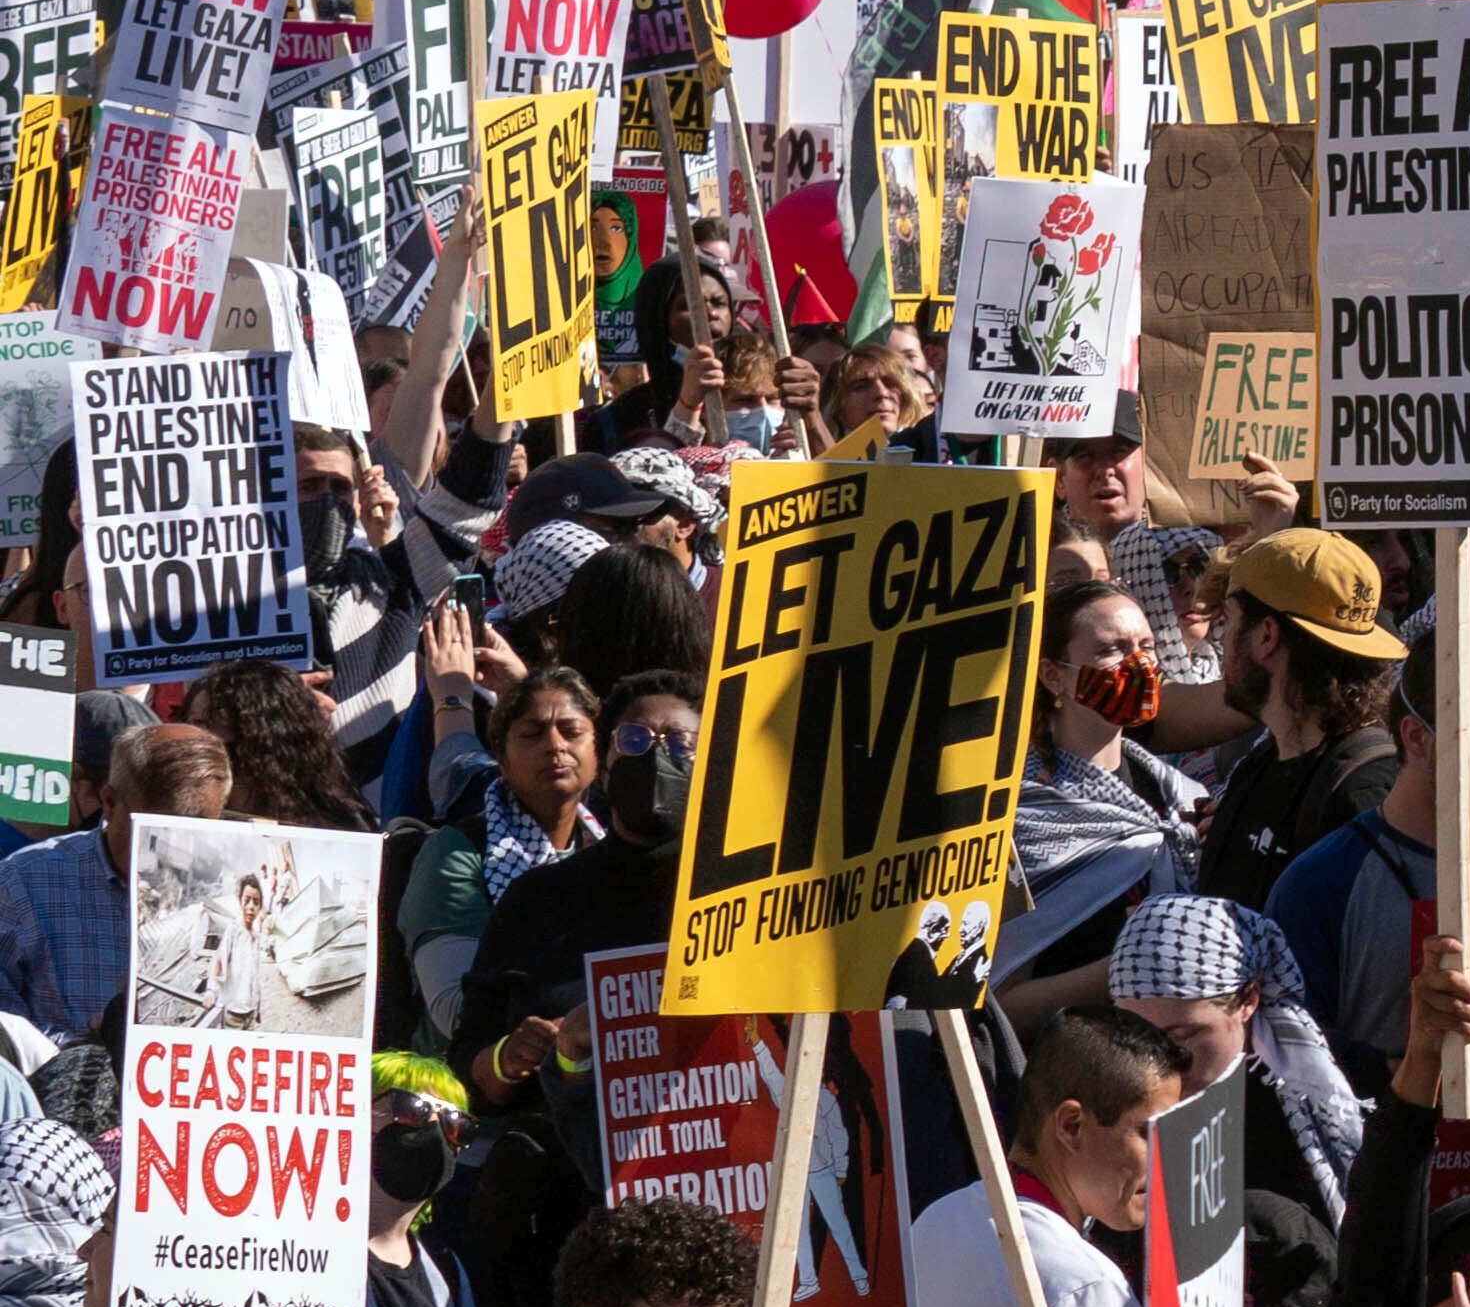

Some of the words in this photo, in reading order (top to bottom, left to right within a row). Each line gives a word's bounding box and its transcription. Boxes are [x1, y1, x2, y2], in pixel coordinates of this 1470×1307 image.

[193, 3, 272, 53] GAZA
[135, 31, 249, 102] LIVE!
[945, 23, 1019, 95] END
[1028, 31, 1091, 103] THE
[1329, 40, 1439, 140] FREE
[102, 123, 186, 166] FREE
[189, 140, 241, 180] ALL
[1013, 104, 1090, 176] WAR
[98, 157, 240, 206] PALESTINIAN
[1164, 151, 1211, 190] US
[91, 179, 235, 231] PRISONERS
[1154, 214, 1300, 255] ALREADY
[71, 266, 216, 340] NOW
[85, 359, 190, 409] STAND
[202, 358, 278, 393] WITH
[983, 380, 1020, 400] LIFT
[1020, 384, 1048, 401] THE
[1049, 386, 1086, 402] SIEGE
[1207, 343, 1313, 412] FREE
[89, 402, 282, 456] PALESTINE!
[975, 402, 999, 419] ON
[999, 402, 1041, 421] GAZA
[1041, 404, 1091, 422] NOW!
[1201, 416, 1307, 466] PALESTINE
[94, 454, 200, 516] END
[210, 445, 285, 505] THE
[1352, 495, 1381, 514] Party
[1384, 494, 1401, 510] for
[1405, 494, 1467, 510] Socialism
[98, 512, 289, 564] OCCUPATION
[741, 480, 861, 540] ANSWER
[107, 552, 294, 651] NOW!
[720, 536, 859, 666] LET
[868, 488, 1040, 634] GAZA
[688, 602, 1037, 901] LIVE!
[683, 894, 750, 969] STOP
[753, 870, 864, 947] FUNDING
[871, 830, 1004, 915] GENOCIDE!
[605, 1026, 660, 1062] AFTER
[136, 1041, 356, 1115] CEASEFIRE
[608, 1060, 758, 1120] GENERATION
[133, 1117, 352, 1221] NOW!
[612, 1125, 667, 1162] UNTIL
[669, 1118, 727, 1154] TOTAL
[1188, 1105, 1227, 1229] FREE
[153, 1234, 330, 1276] #CeaseFireNow
